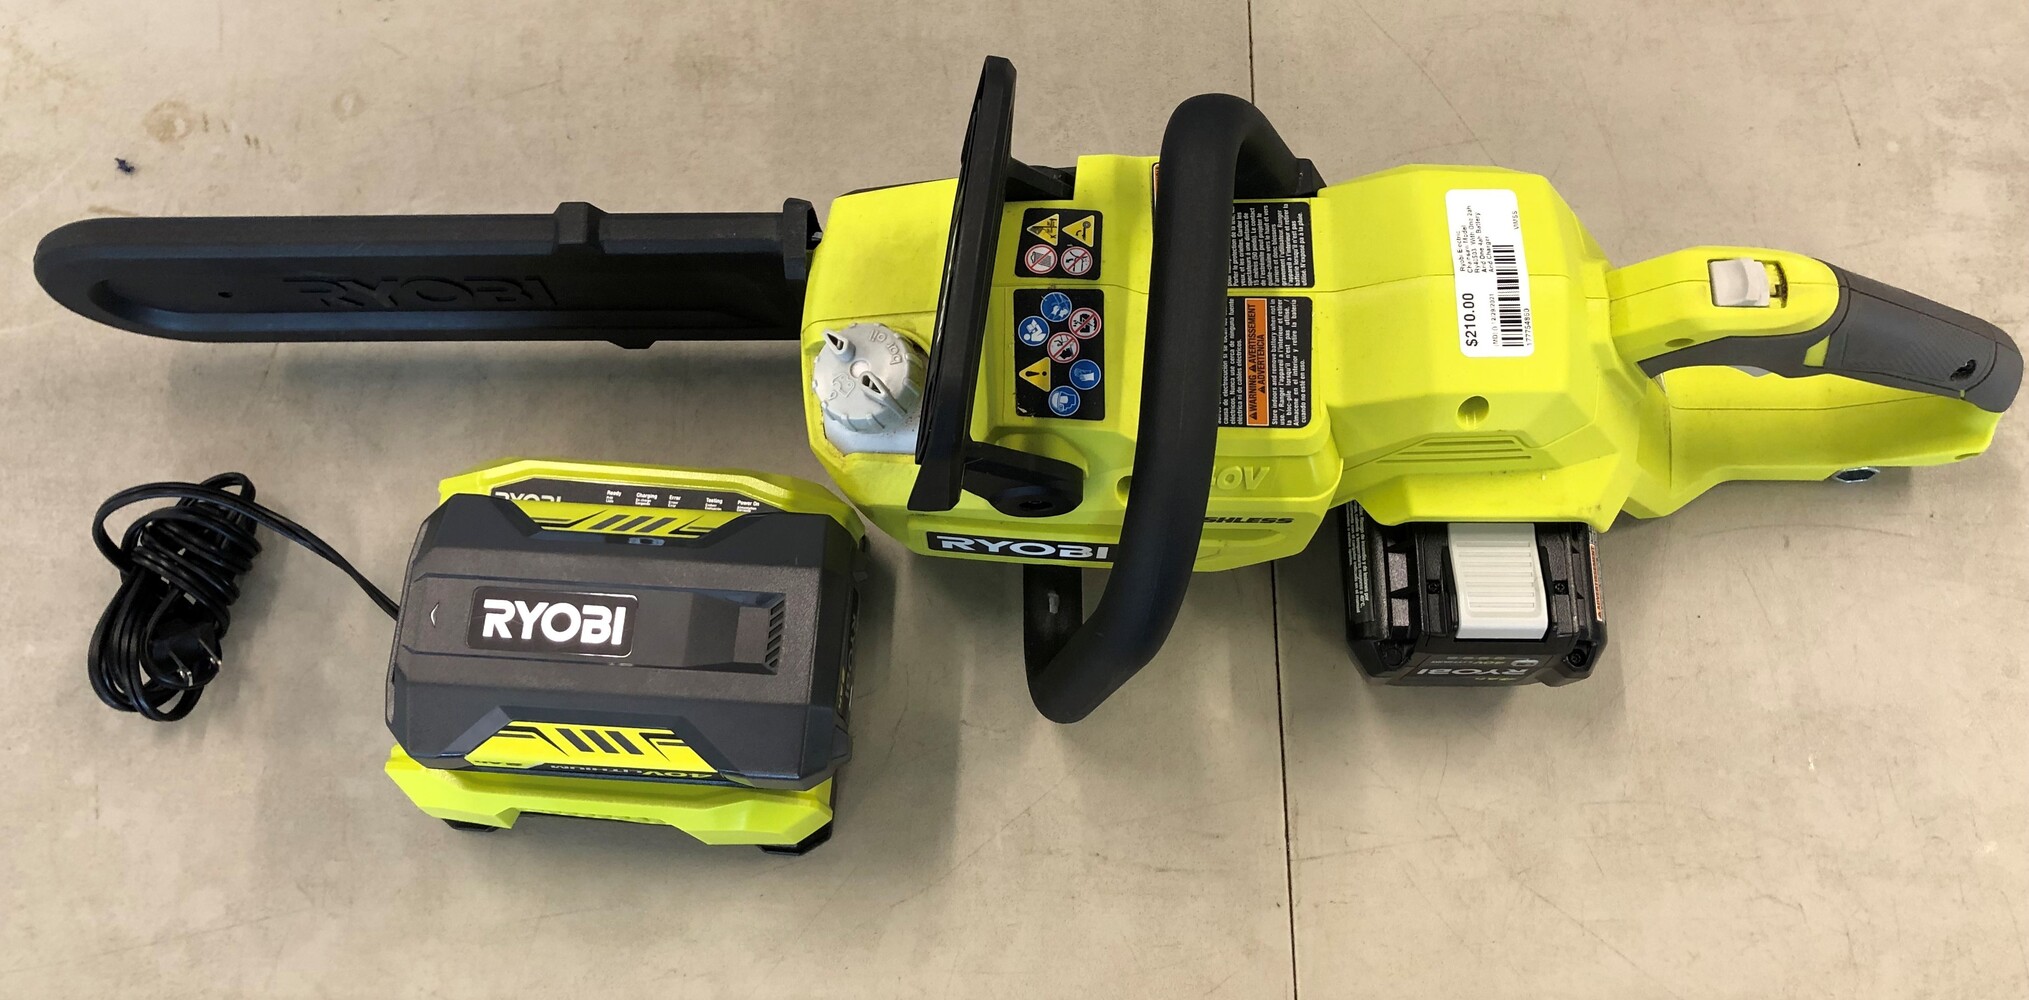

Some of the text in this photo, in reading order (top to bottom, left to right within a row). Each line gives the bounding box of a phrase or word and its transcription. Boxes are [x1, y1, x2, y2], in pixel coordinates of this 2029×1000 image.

[282, 276, 556, 306] RYOBI
[1248, 304, 1256, 363] AVERTISSEMENT
[1462, 293, 1478, 347] $210.00
[869, 329, 903, 365] bar oil
[1277, 360, 1285, 385] l'appareil
[1212, 466, 1270, 490] 0V
[936, 536, 1108, 559] RYOBI
[482, 599, 626, 646] RYOBI
